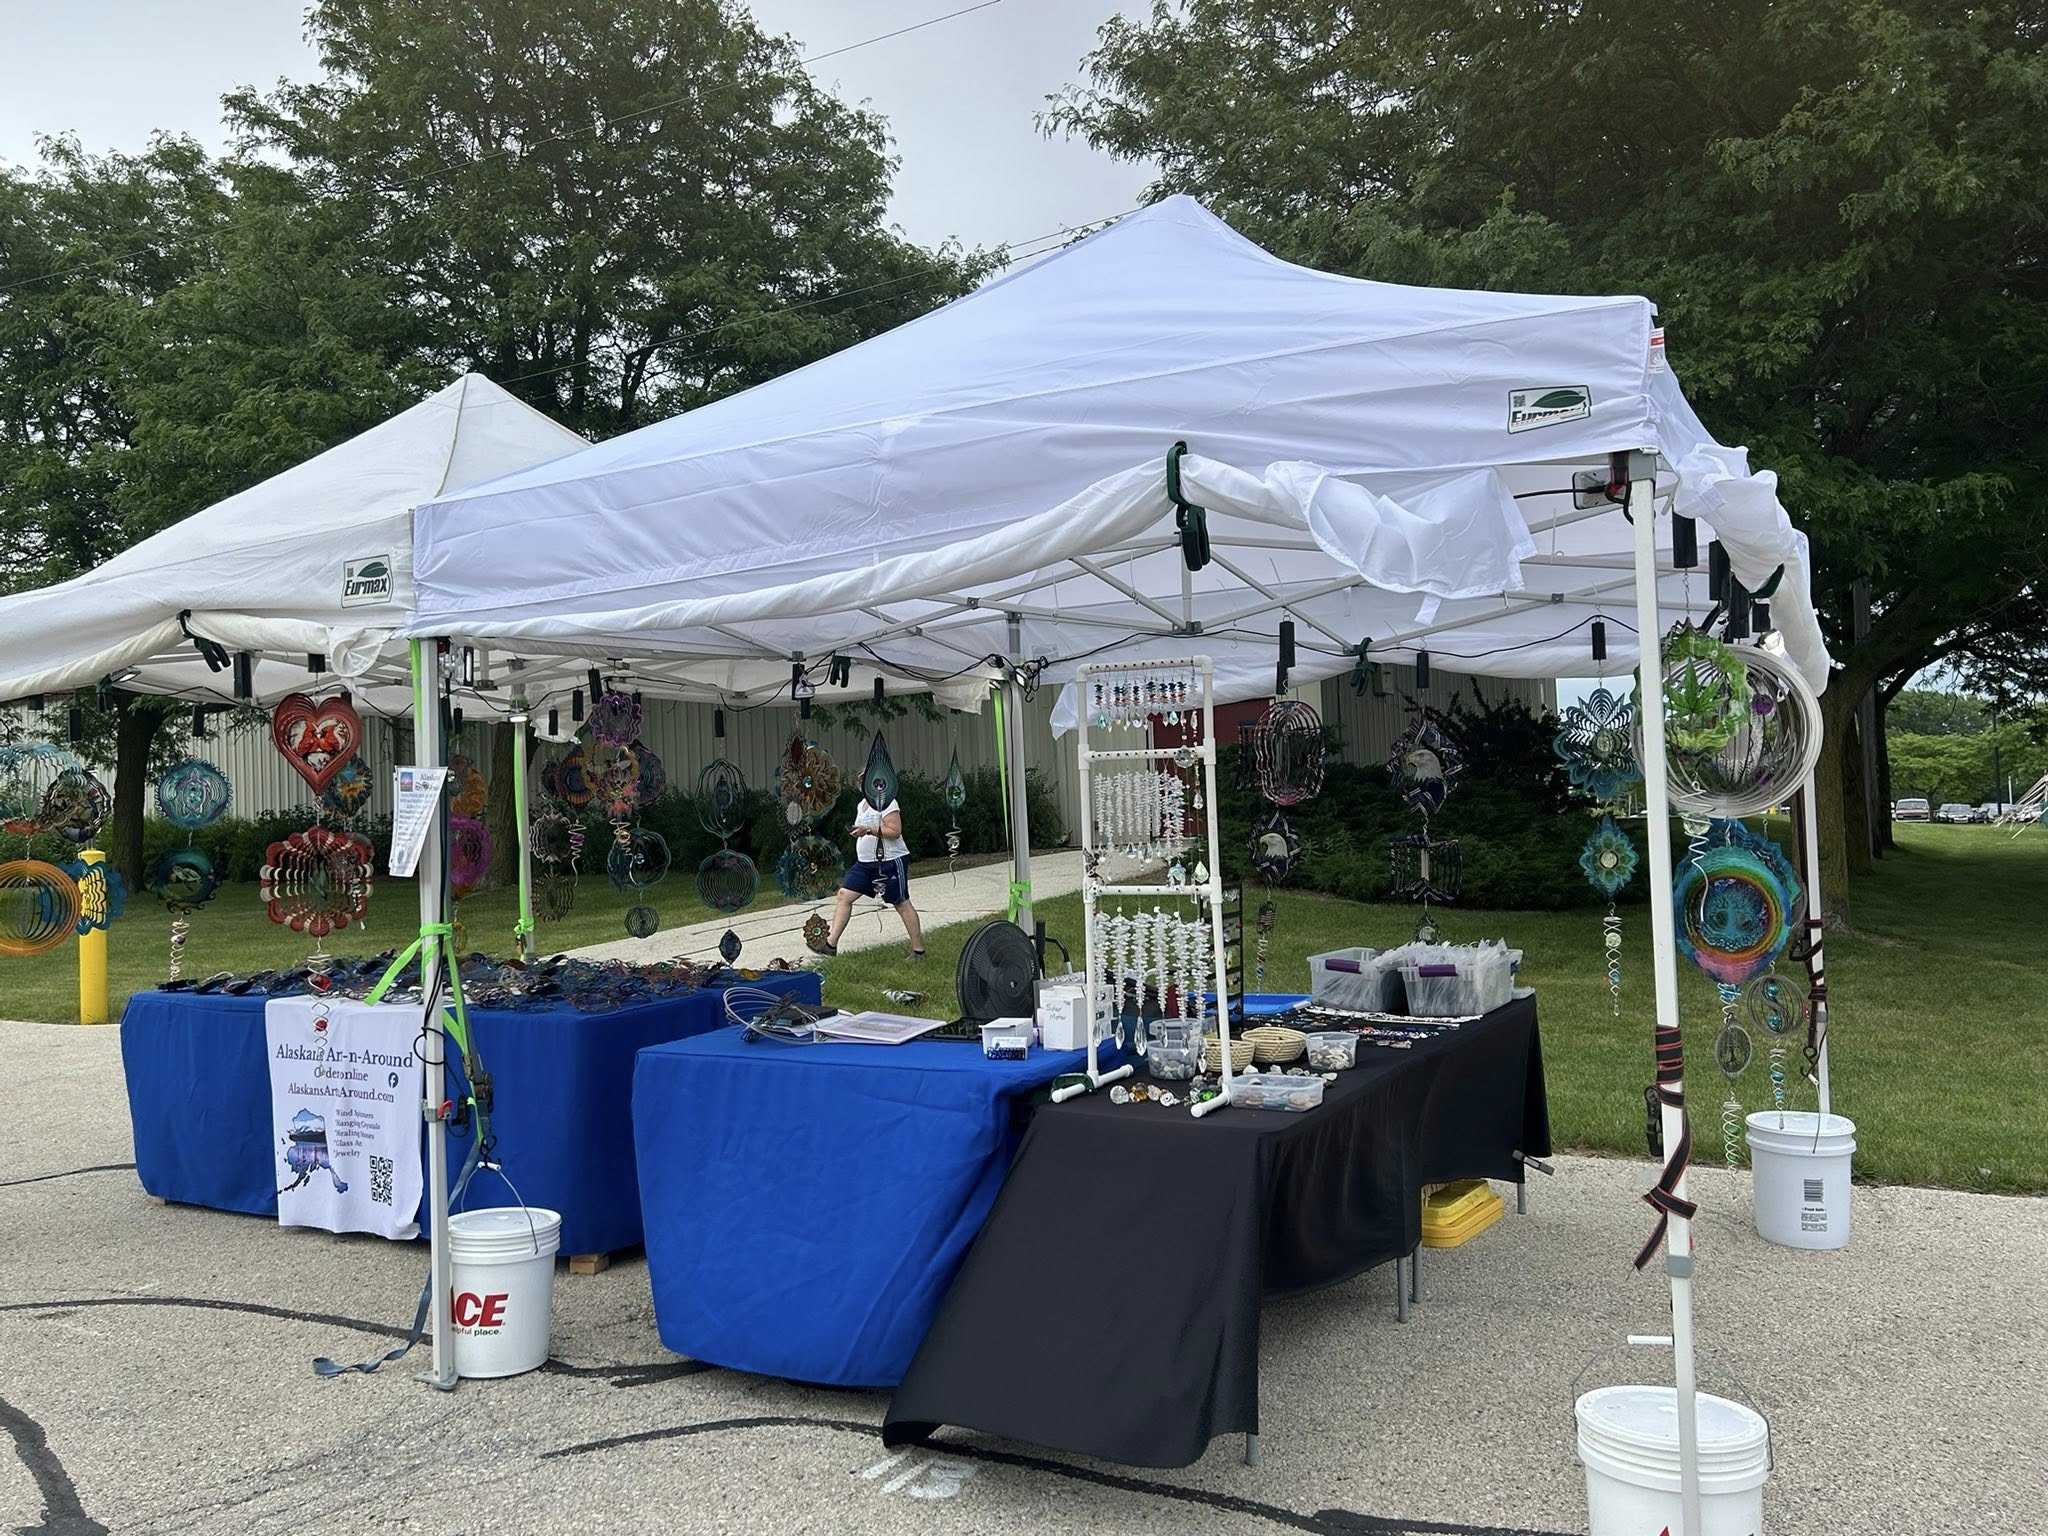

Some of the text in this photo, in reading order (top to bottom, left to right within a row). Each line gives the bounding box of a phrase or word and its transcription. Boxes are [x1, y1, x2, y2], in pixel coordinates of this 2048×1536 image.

[344, 577, 388, 597] Eurmax
[326, 1047, 413, 1068] Ar-n-Around
[288, 1083, 395, 1103] AlaskansArtAround.com
